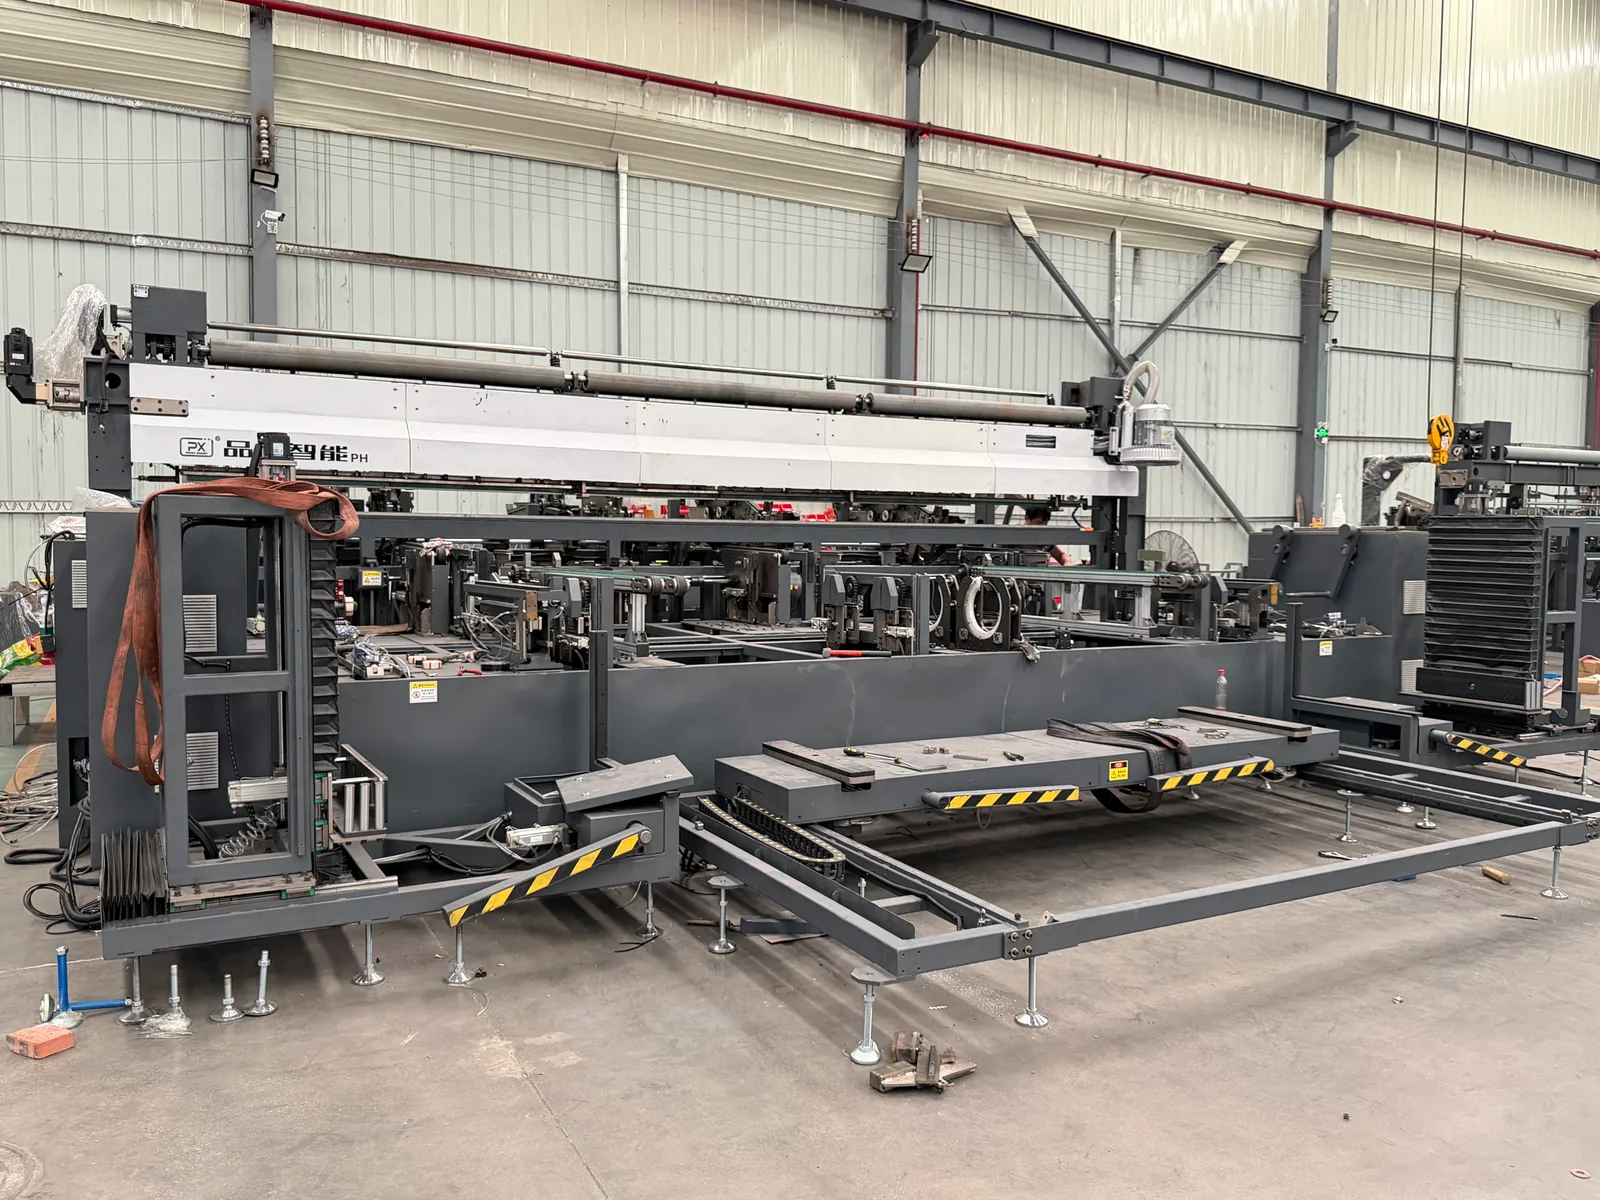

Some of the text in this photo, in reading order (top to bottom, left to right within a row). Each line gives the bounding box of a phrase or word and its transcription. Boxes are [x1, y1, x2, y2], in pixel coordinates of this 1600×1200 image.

[187, 441, 206, 452] PX
[224, 440, 348, 462] 品智能
[351, 453, 368, 463] PH
